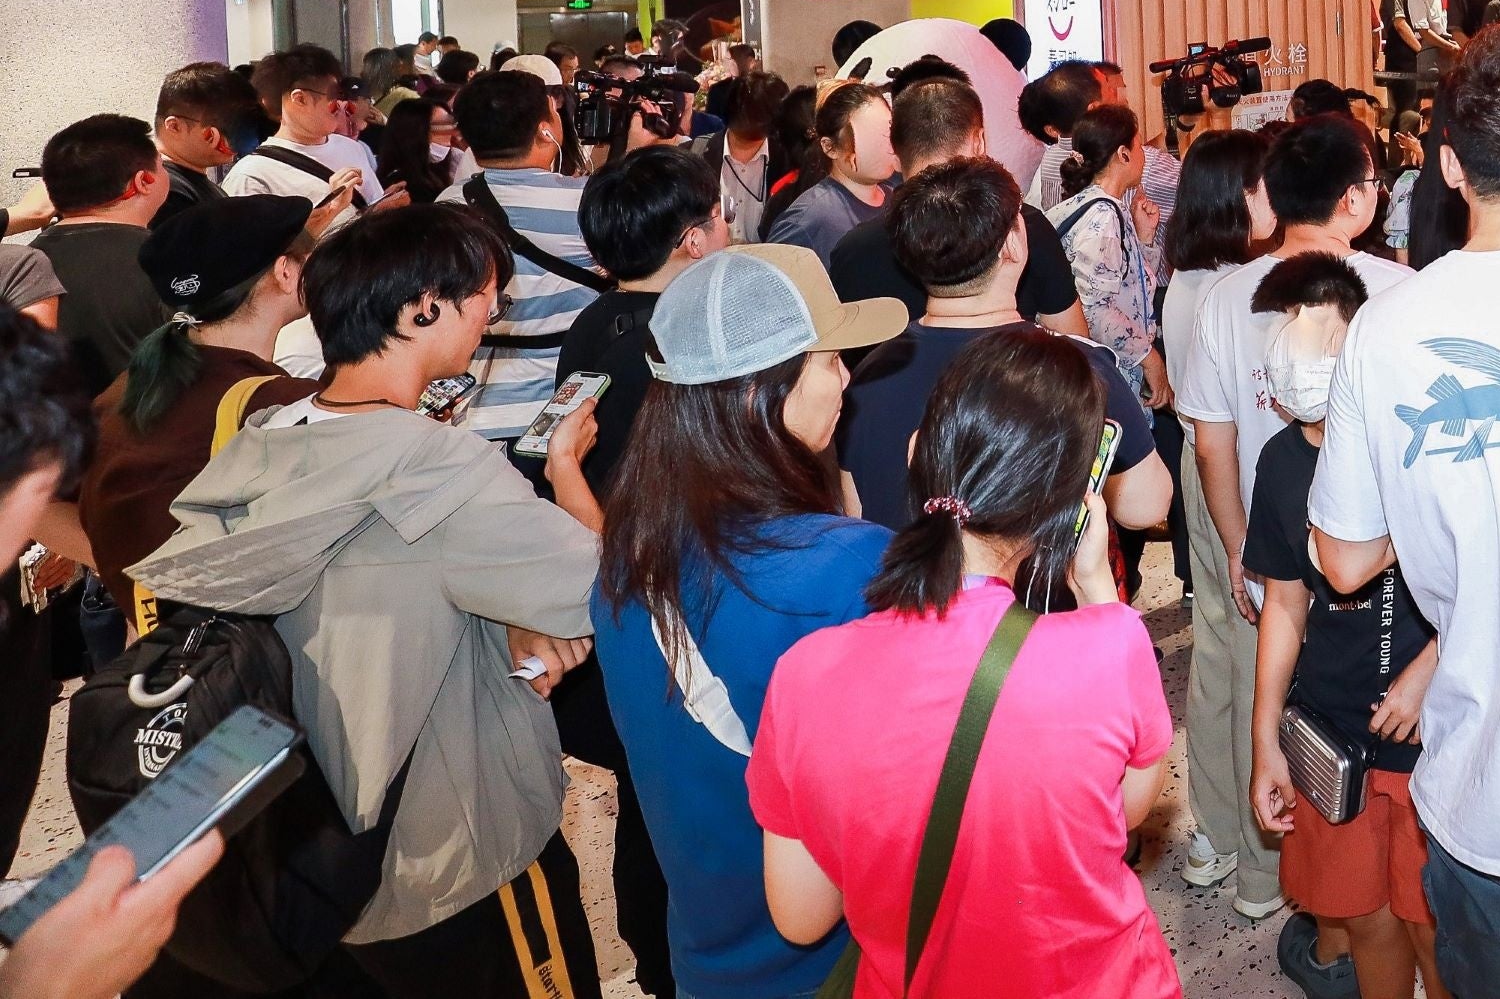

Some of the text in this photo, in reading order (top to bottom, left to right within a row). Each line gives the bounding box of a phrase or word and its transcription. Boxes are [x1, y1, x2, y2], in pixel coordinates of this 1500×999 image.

[1263, 66, 1306, 77] HYDRANT
[1380, 568, 1395, 627] FOREVER
[1379, 631, 1393, 674] YOUNG
